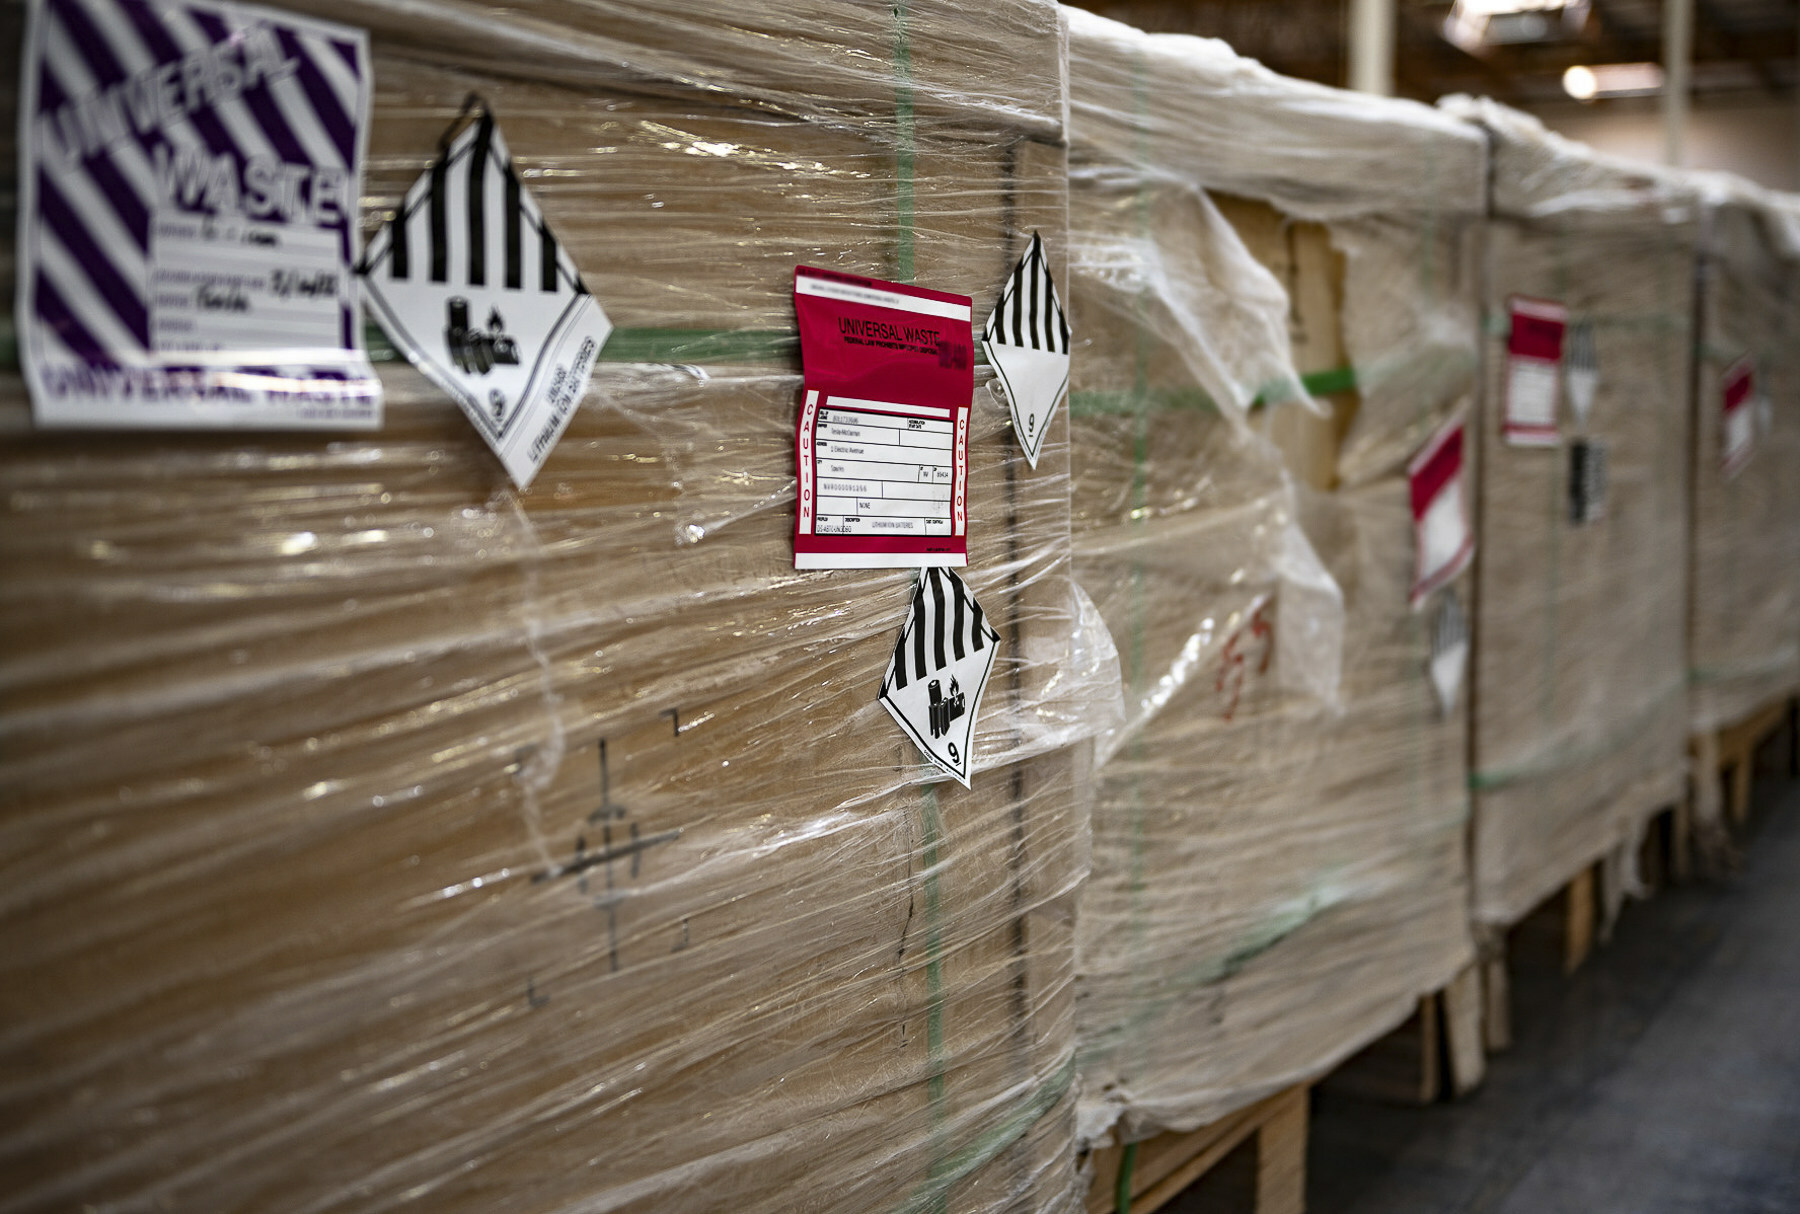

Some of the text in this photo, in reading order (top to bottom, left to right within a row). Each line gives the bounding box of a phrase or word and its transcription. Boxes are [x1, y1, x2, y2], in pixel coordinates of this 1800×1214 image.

[40, 19, 299, 171] UNIVERSAL
[153, 142, 347, 226] WASTE
[838, 316, 941, 347] UNIVERSAL WASTE
[527, 415, 560, 464] LITHIUM
[557, 394, 572, 415] ION
[803, 403, 814, 518] CAUTION
[1029, 413, 1034, 432] 9
[956, 419, 965, 521] CAUTION
[948, 742, 960, 763] 9
